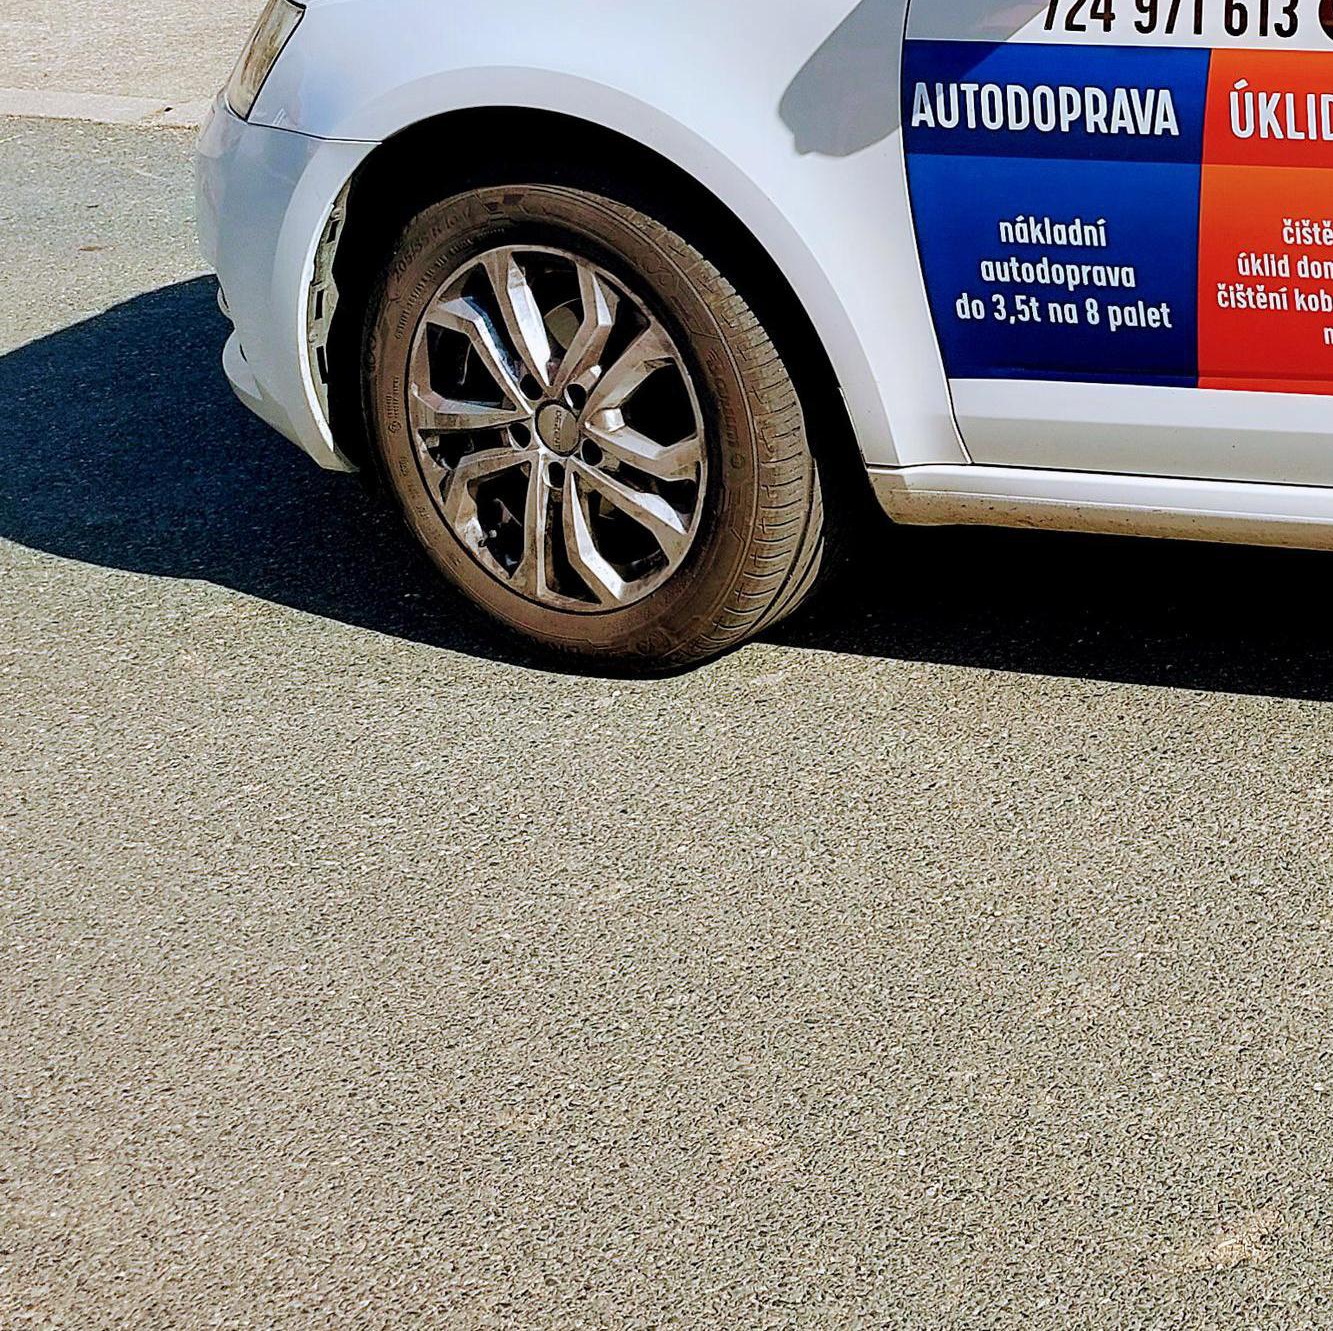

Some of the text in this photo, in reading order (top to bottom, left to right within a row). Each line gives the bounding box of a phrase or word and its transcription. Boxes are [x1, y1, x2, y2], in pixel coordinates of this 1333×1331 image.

[911, 82, 1180, 136] AUTODOPRAVA
[999, 215, 1107, 247] nákladní
[980, 257, 1136, 292] autodoprava
[1237, 252, 1290, 278] úklid
[955, 292, 1172, 332] do 3,5t na 8 palet
[1217, 283, 1288, 310] čištění
